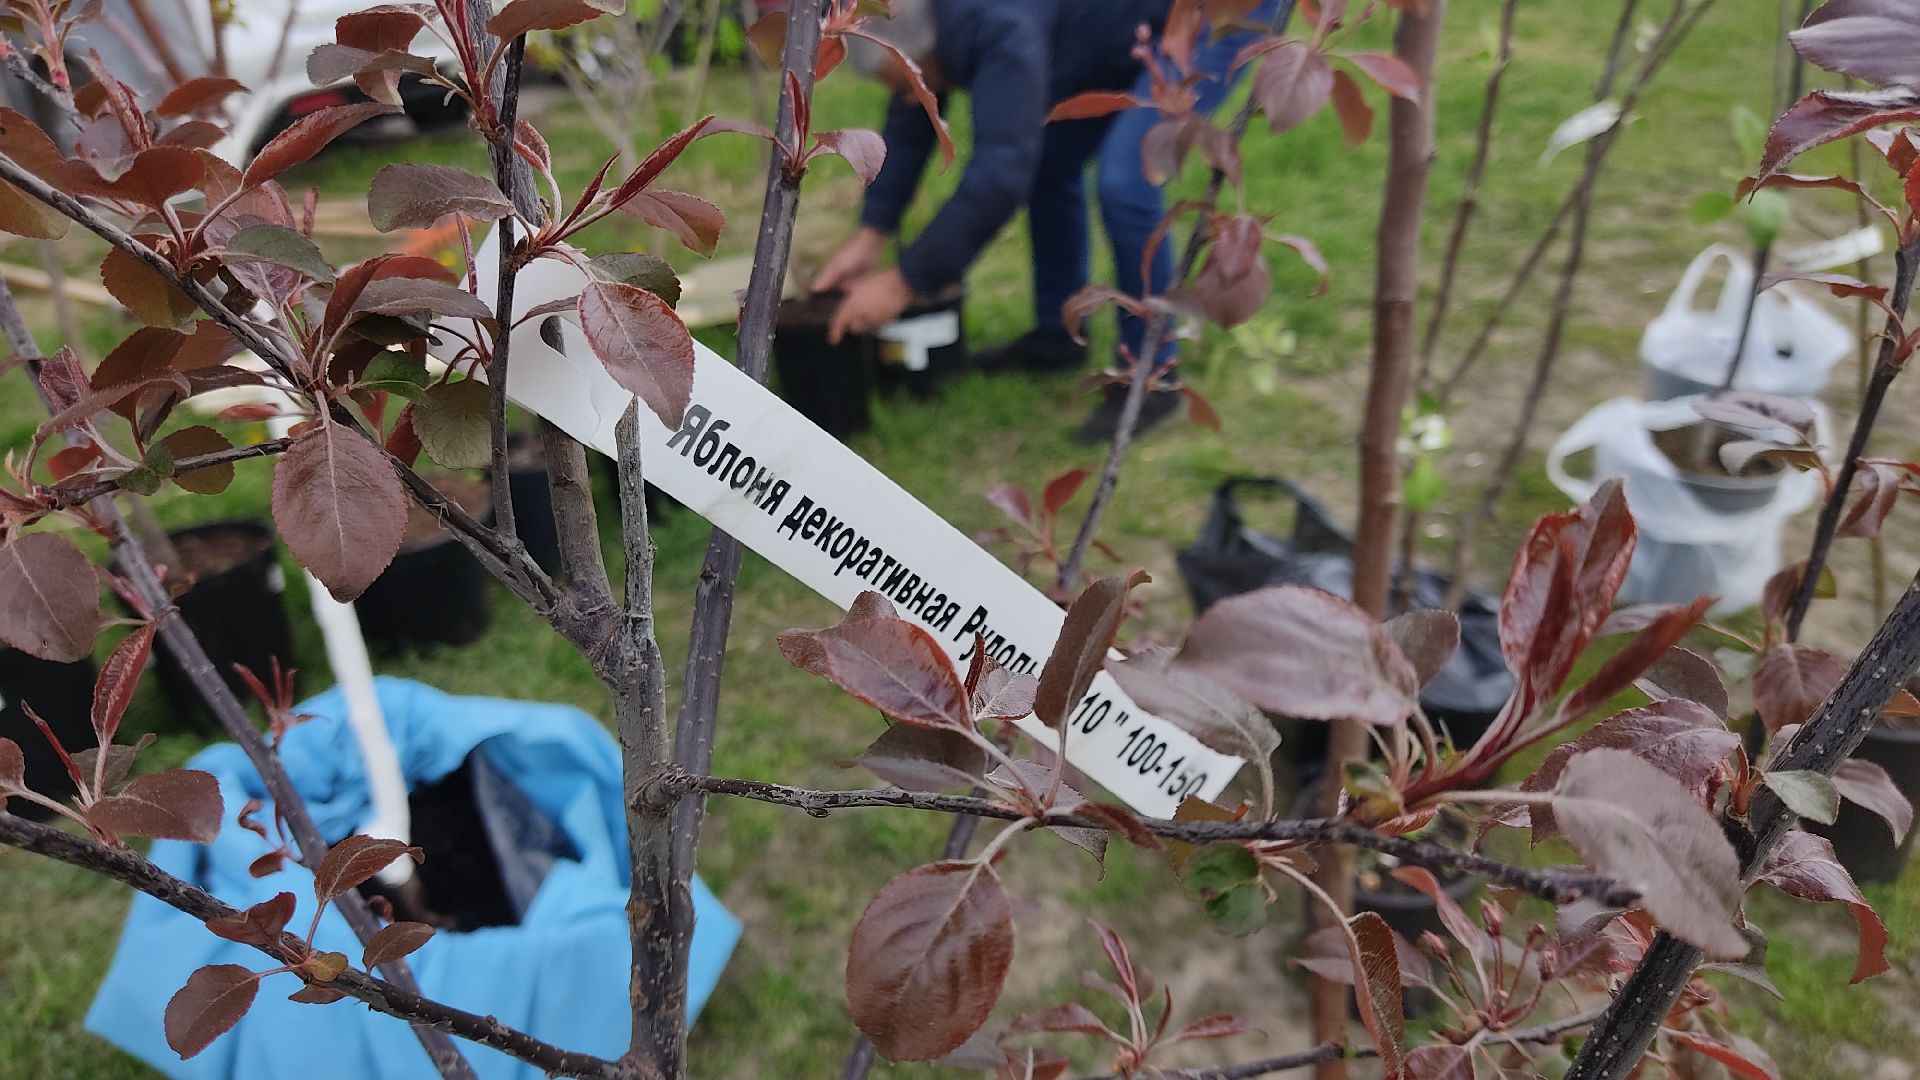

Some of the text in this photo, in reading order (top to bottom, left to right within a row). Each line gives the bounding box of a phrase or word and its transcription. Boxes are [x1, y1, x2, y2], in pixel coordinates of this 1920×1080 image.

[666, 404, 791, 516] Яблоня
[776, 495, 961, 632] декоративная
[1117, 726, 1207, 802] 100-150
